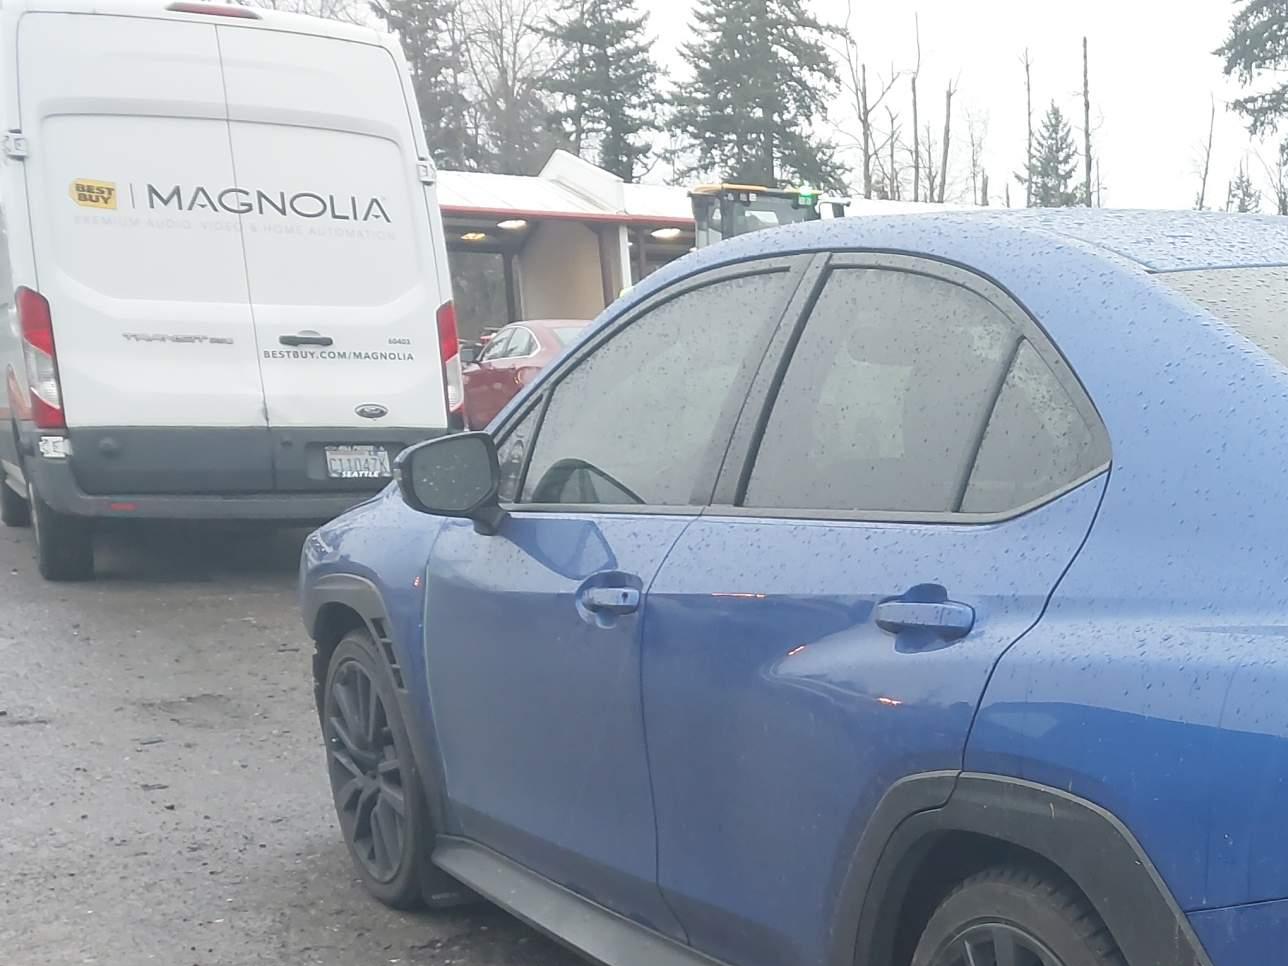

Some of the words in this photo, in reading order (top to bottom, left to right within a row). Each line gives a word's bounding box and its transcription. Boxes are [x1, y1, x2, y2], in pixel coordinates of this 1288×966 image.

[75, 183, 115, 196] BEST
[77, 193, 112, 205] BUY
[147, 183, 391, 223] MAGNOLIA
[74, 215, 140, 228] PREMIUM
[199, 220, 240, 233] VIDEO
[263, 224, 303, 236] HOME
[308, 226, 397, 241] AUTOMATION
[263, 350, 414, 361] BESTBUY.COM/MAGNOLIA
[342, 470, 379, 478] SEATTLE
